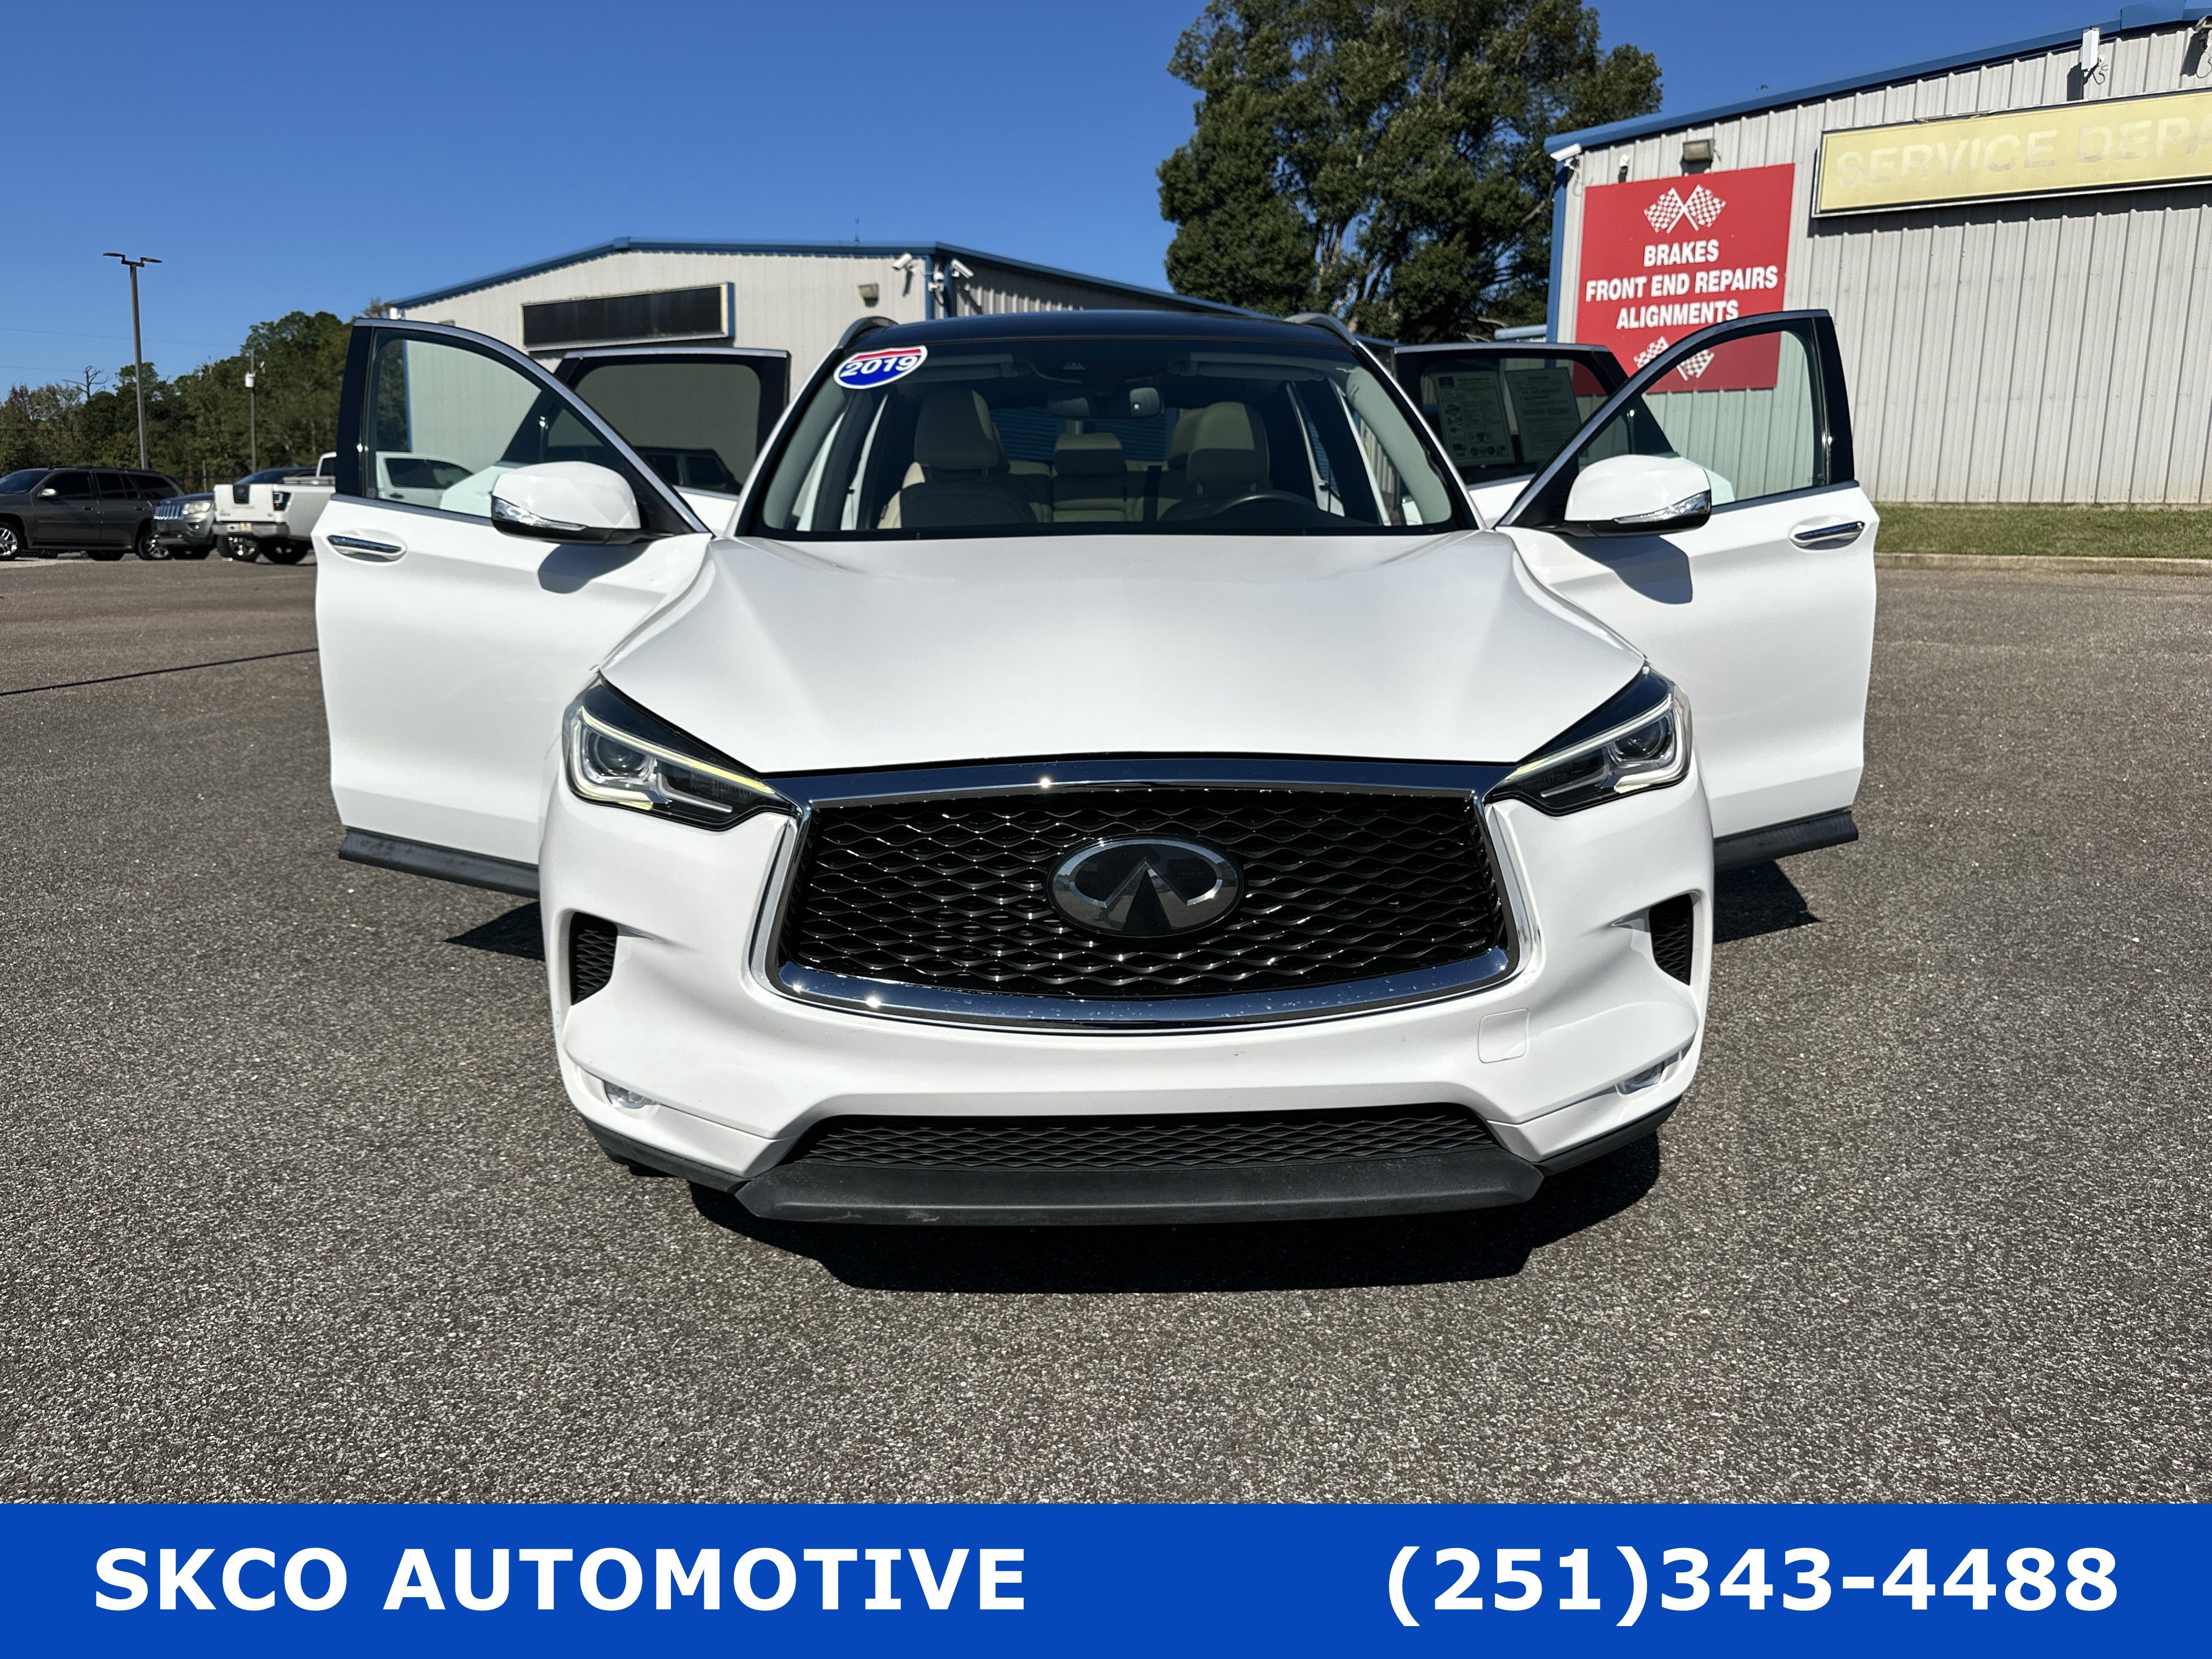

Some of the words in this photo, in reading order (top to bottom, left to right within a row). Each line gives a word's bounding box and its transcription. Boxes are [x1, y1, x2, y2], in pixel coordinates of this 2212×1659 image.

[1836, 130, 2057, 189] SERVICE
[1644, 239, 1719, 267] BRAKES
[1585, 277, 1647, 302] FRONT
[1651, 273, 1690, 297] END
[1695, 266, 1778, 294] REPAIRS
[1616, 300, 1739, 329] ALIGNMENTS
[839, 356, 918, 377] 2019
